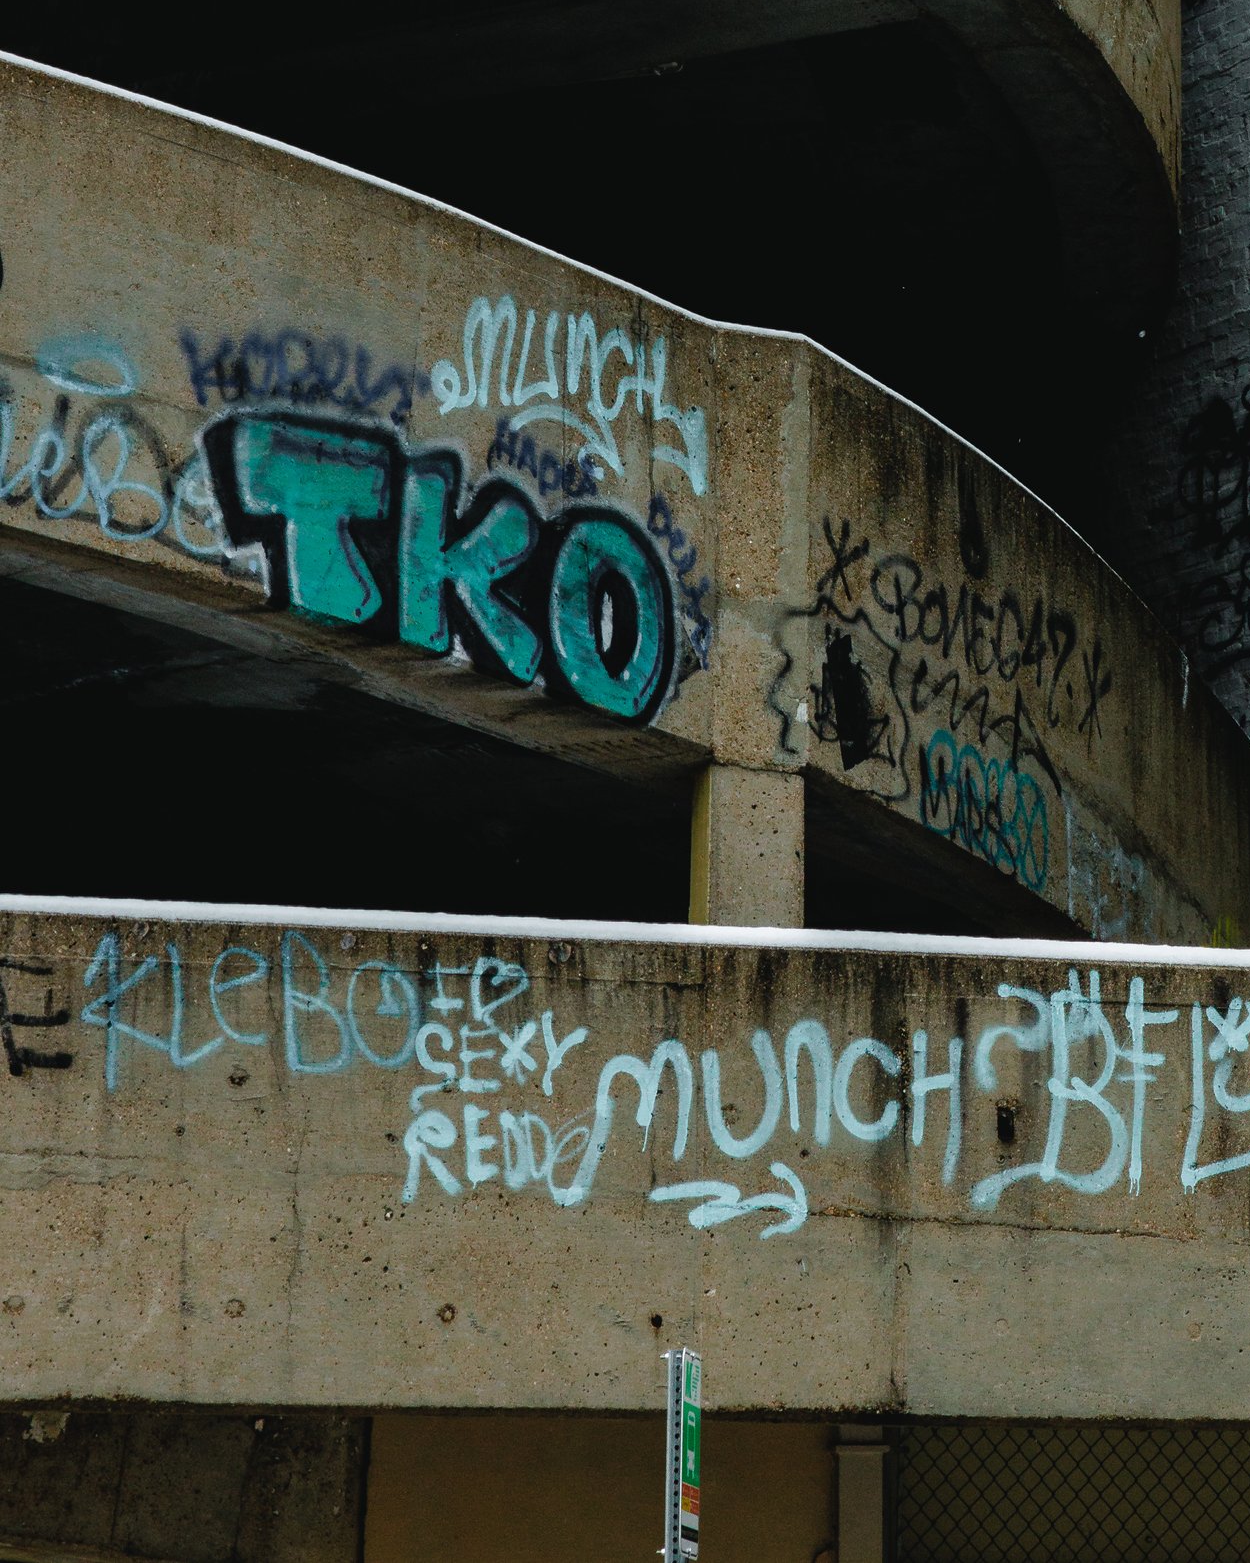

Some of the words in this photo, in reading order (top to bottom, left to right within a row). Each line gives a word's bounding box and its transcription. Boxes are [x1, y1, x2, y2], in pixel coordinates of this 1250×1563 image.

[203, 405, 680, 726] TKO
[412, 1009, 589, 1102] SEXY
[560, 1024, 967, 1202] MUNCH
